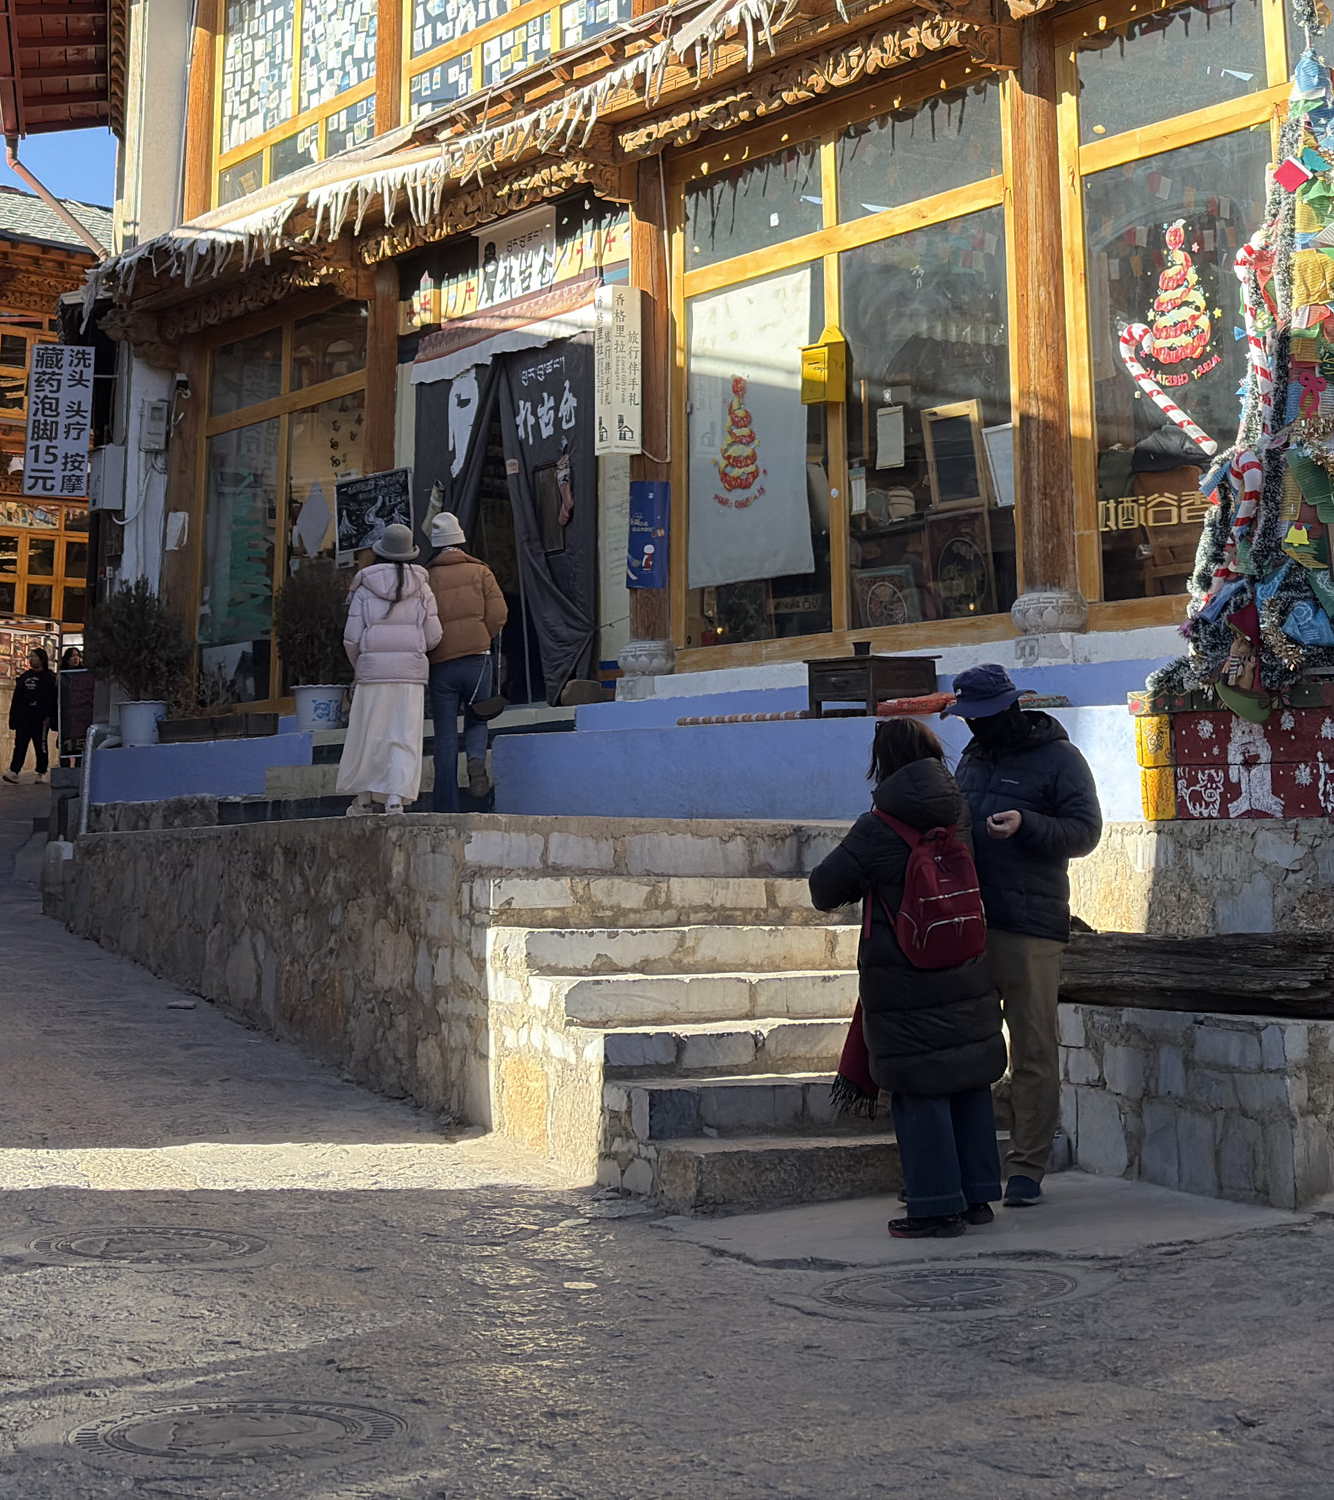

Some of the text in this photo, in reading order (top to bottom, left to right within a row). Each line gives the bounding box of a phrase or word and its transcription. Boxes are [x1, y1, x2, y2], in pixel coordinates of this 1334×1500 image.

[613, 293, 627, 354] 香格里拉
[627, 330, 640, 407] 旅行伴手礼
[27, 346, 65, 492] 藏药泡脚15元
[60, 348, 92, 494] 洗头 头疗 按摩
